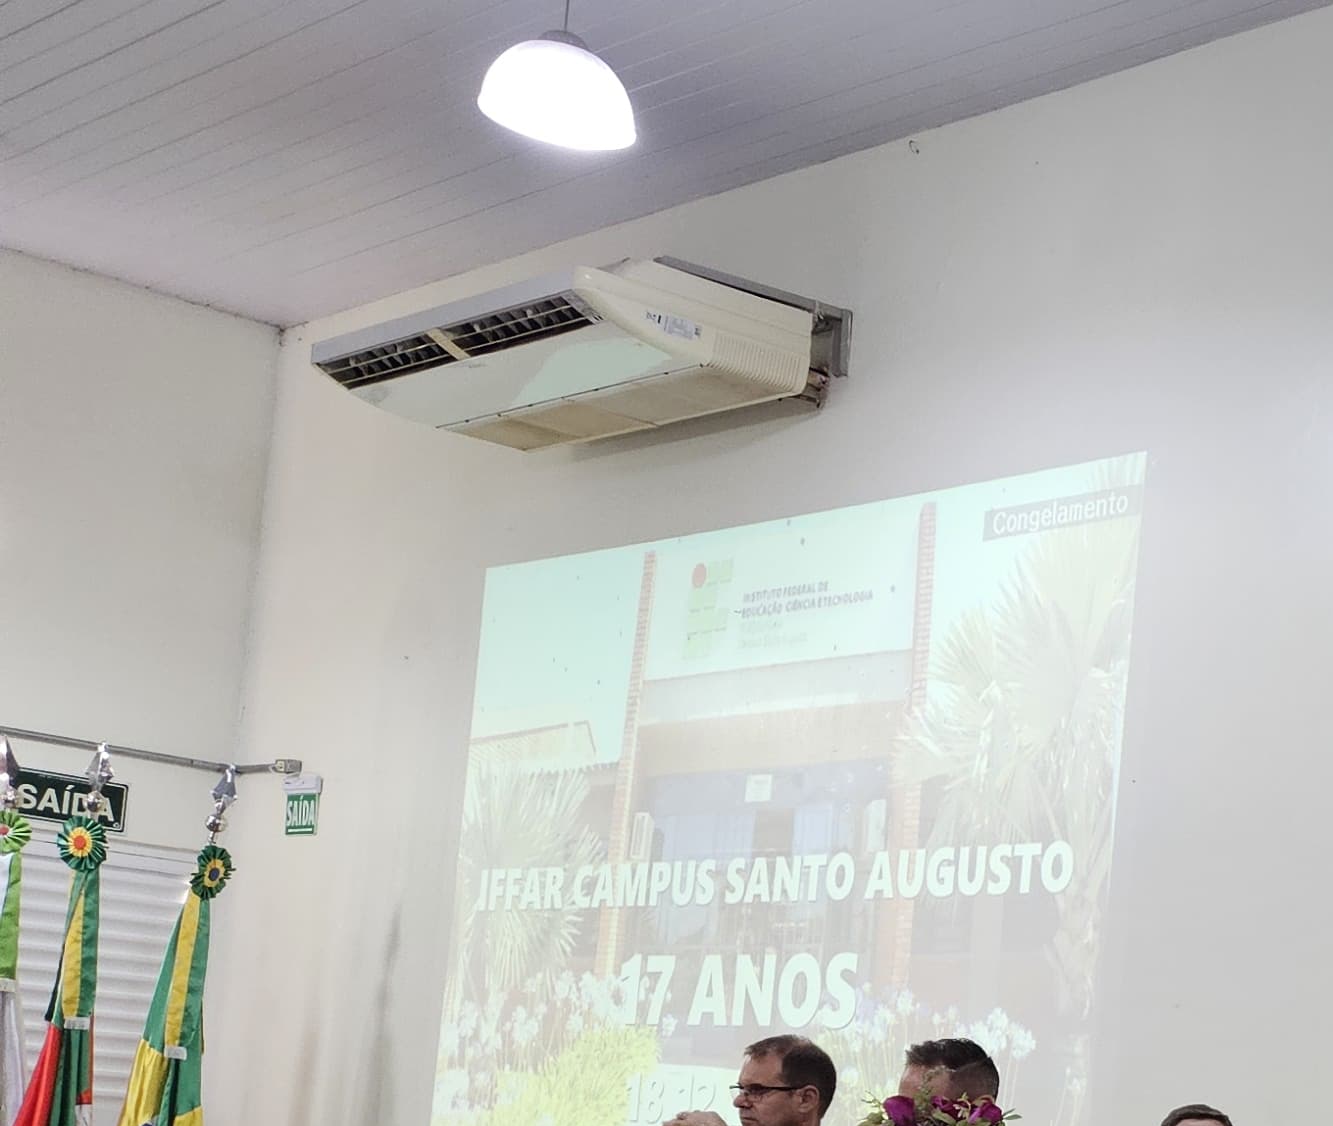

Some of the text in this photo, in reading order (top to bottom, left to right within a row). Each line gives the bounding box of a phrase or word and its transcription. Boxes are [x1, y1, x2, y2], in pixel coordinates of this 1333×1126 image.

[993, 491, 1129, 535] Congelamento
[743, 580, 830, 604] INSTITUTO FEDERAL DE
[17, 783, 114, 822] SAÍDA
[287, 795, 315, 827] SAÍDA
[476, 840, 1074, 912] IFFAR CAMPUS SANTO AUGUSTO
[618, 951, 860, 1030] 17 ANOS
